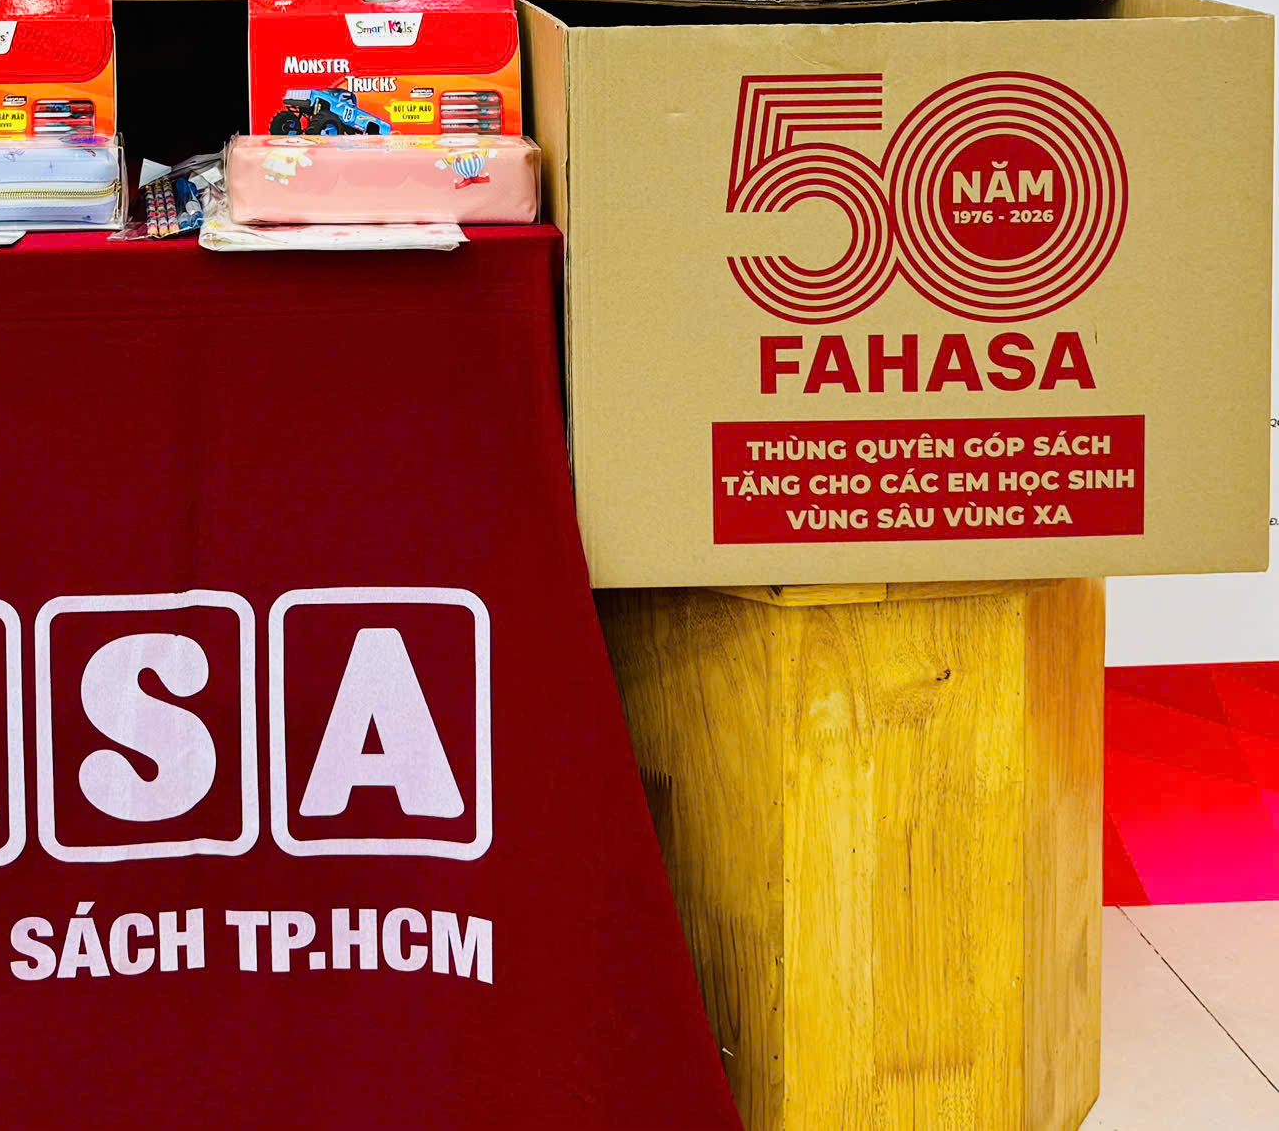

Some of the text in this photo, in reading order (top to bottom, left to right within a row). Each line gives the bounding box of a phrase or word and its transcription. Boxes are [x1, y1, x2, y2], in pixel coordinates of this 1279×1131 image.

[283, 56, 350, 74] MONSTER
[345, 75, 398, 93] TRUCKS
[343, 108, 353, 120] 18
[726, 70, 1129, 325] 50
[952, 160, 1054, 204] NĂM
[952, 210, 993, 224] 1976
[1009, 209, 1054, 224] 2026
[760, 331, 1097, 395] FAHASA
[746, 429, 1111, 464] THÙNG QUYÊN GÓP SÁCH
[721, 467, 1135, 502] TẶNG CHO CÁC EM HỌC SINH
[786, 500, 1073, 530] VÙNG SÂU VÙNG XA
[7, 903, 208, 985] SÁCH
[223, 905, 495, 987] TP.HCM
